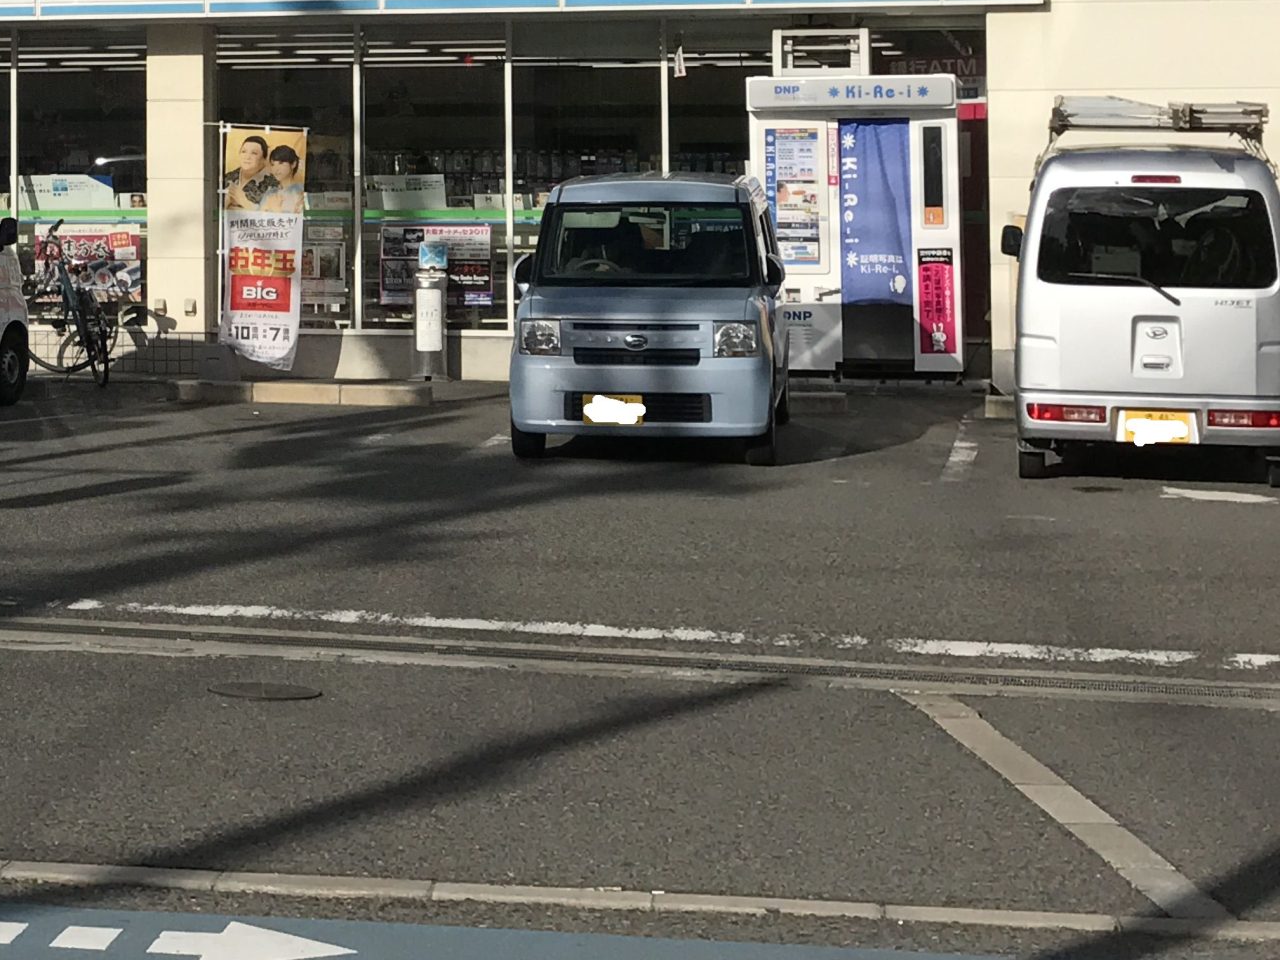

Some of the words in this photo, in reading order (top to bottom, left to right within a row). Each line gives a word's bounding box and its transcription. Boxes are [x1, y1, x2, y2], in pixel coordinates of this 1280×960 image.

[774, 85, 800, 95] DNP
[229, 246, 296, 274] お年玉
[860, 254, 904, 264] 証明写真は
[242, 280, 278, 300] BIG
[783, 311, 813, 321] DNP
